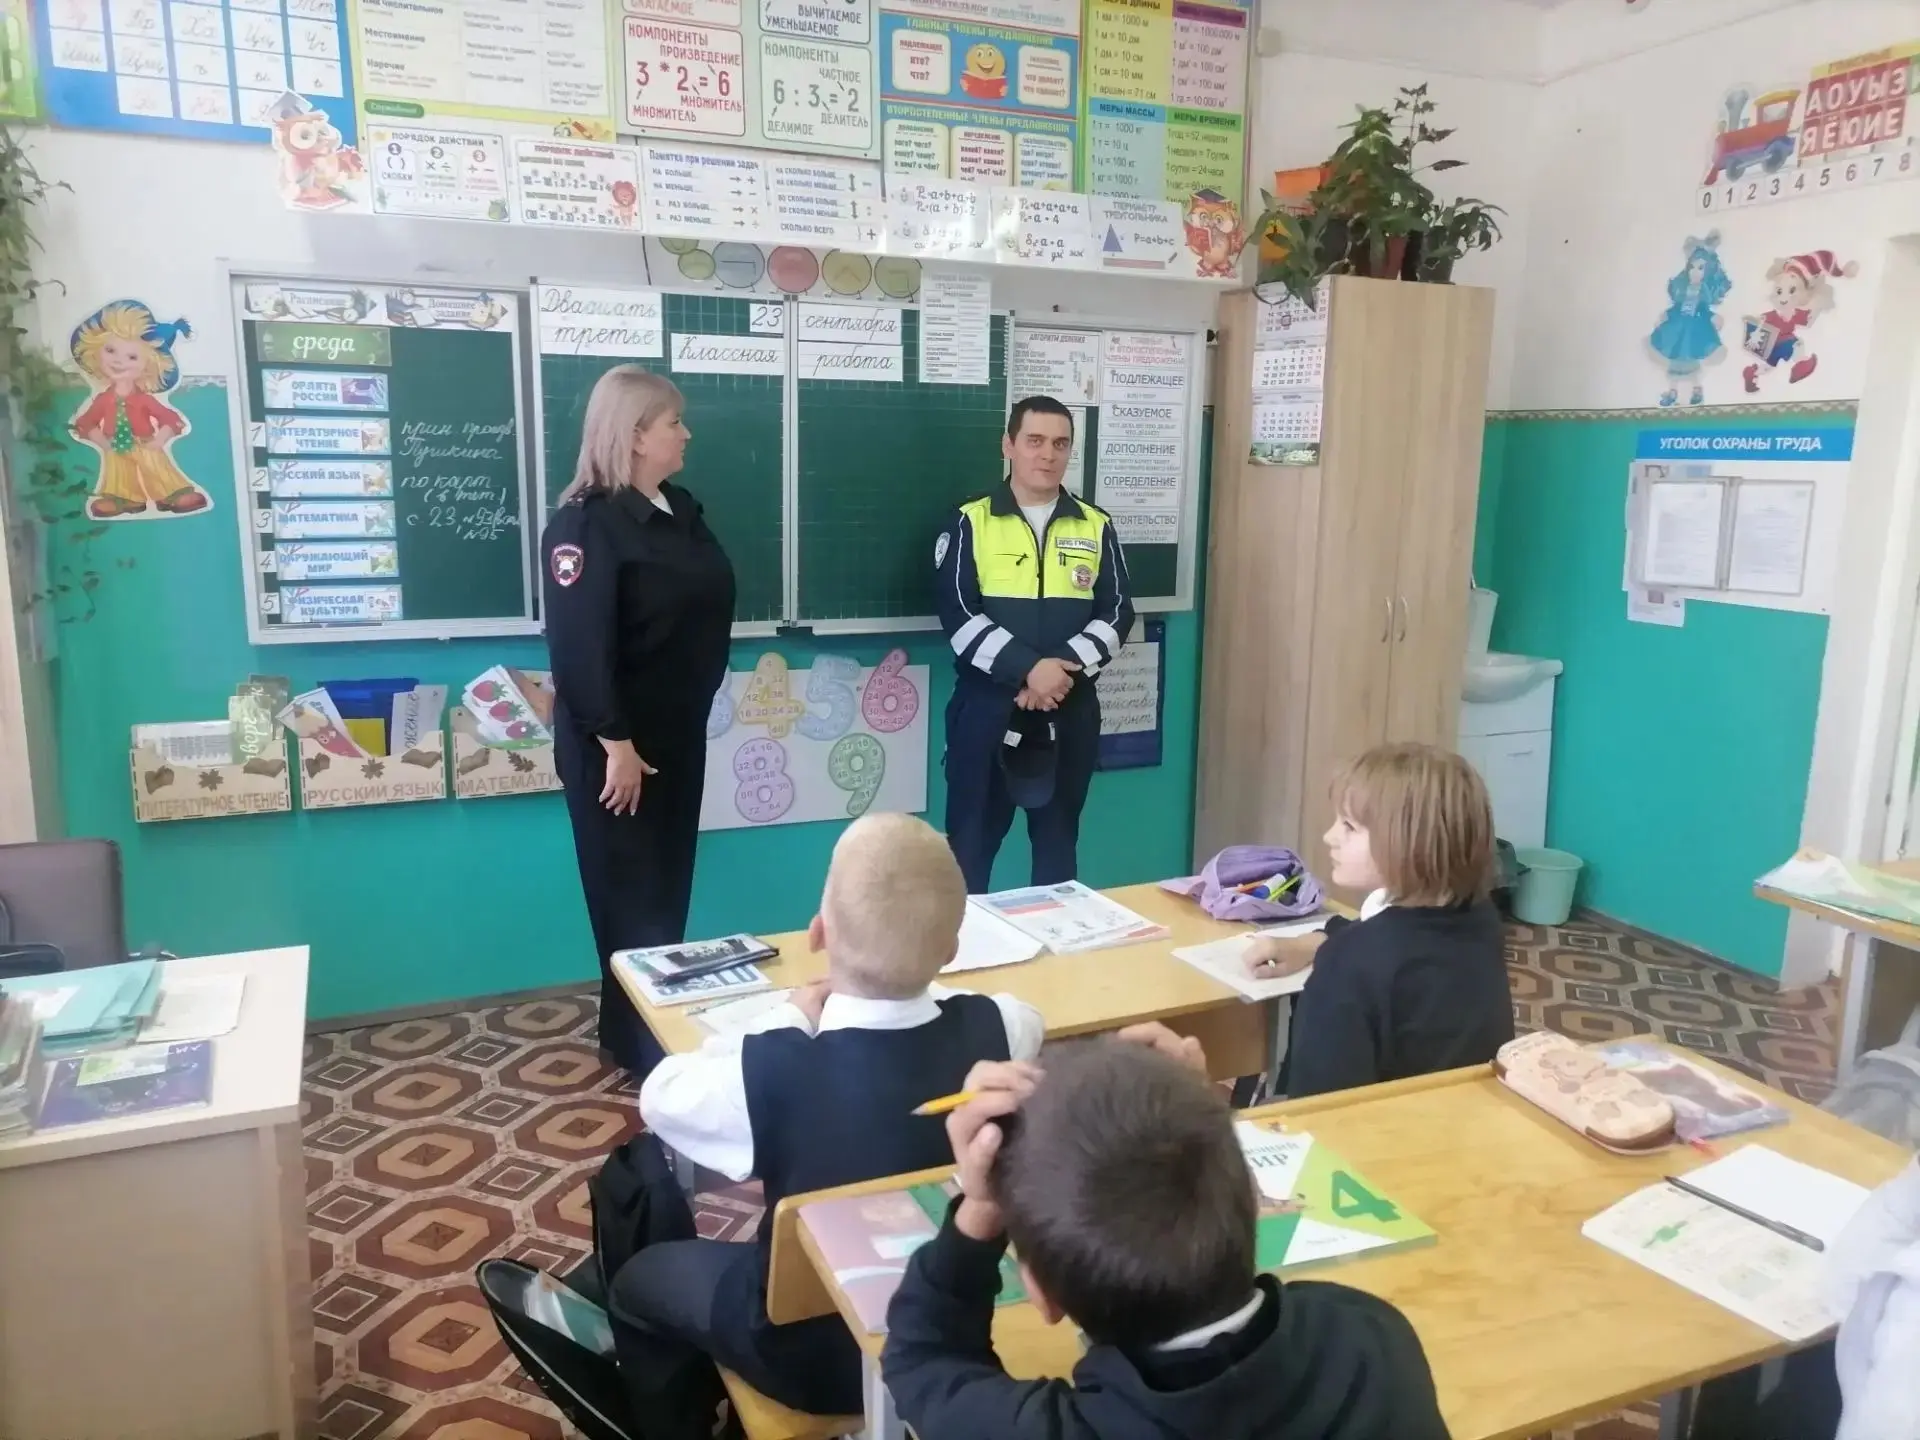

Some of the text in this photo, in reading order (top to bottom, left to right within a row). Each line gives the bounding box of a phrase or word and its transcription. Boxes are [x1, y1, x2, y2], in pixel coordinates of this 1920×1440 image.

[798, 4, 862, 24] ВЫЧИТАЕМОЕ
[629, 23, 708, 46] КОМПОНЕНТЫ
[765, 15, 839, 36] УМЕНЬШАЕМОЕ
[660, 44, 741, 66] ПРОИЗВЕДЕНИЕ
[765, 42, 839, 64] КОМПОНЕНТЫ
[636, 61, 650, 87] 3
[677, 66, 689, 92] 2
[718, 71, 730, 97] 6
[819, 68, 861, 83] ЧАСТНОЕ
[680, 95, 742, 113] МНОЖИТЕЛЬ
[773, 79, 785, 104] 6
[808, 84, 821, 107] 3
[847, 88, 859, 112] 2
[632, 105, 697, 122] МНОЖИТЕЛЬ
[1100, 103, 1155, 118] МЕРЫ МАССЫ
[767, 120, 814, 135] ДЕЛИМОЕ
[820, 112, 868, 128] ДЕЛИТЕЛЬ
[392, 132, 435, 143] ПОРЯДОК
[685, 154, 699, 165] при
[1703, 153, 1911, 208] 0 1 2 3 4 5 6 7 8
[1103, 210, 1168, 222] ТРЕУГОЛЬНИКА
[1113, 201, 1157, 213] ПЕРИМЕТР
[752, 306, 783, 328] 23
[805, 308, 897, 340] сентября
[293, 333, 355, 360] среда
[554, 326, 655, 354] третье
[678, 335, 778, 362] Классная
[813, 345, 893, 376] работа
[1111, 373, 1184, 386] ПОДЛЕЖАЩЕЕ
[1113, 406, 1172, 418] СКАЗУЕМОЕ
[295, 439, 341, 448] ЧТЕНИЕ
[1105, 444, 1176, 455] ДОПОЛНЕНИЕ
[1660, 437, 1822, 451] УГОЛОК ОХРАНЫ ТРУДА
[252, 469, 266, 487] 2
[328, 470, 361, 480] ЯЗЫК
[1104, 476, 1177, 488] ОПРЕДЕЛЕНИЕ
[256, 511, 272, 529] 3
[278, 513, 359, 522] МАТЕМАТИКА
[1111, 516, 1177, 526] СТОЯТЕЛЬСТВО
[260, 553, 272, 570] 4
[280, 549, 369, 562] ОКРУЖАЮЩИЙ
[307, 563, 332, 573] МИР
[261, 594, 277, 612] 5
[301, 606, 359, 616] КУЛЬТУРА
[862, 648, 919, 733] 6
[460, 772, 562, 795] МАТЕМАТИ
[733, 737, 794, 823] 8
[828, 733, 886, 817] 9
[392, 780, 439, 798] ЯЗЫК
[140, 791, 285, 817] ЛИТЕРАТУРНОЕ ЧТЕНИЕ
[1331, 1169, 1402, 1223] 4
